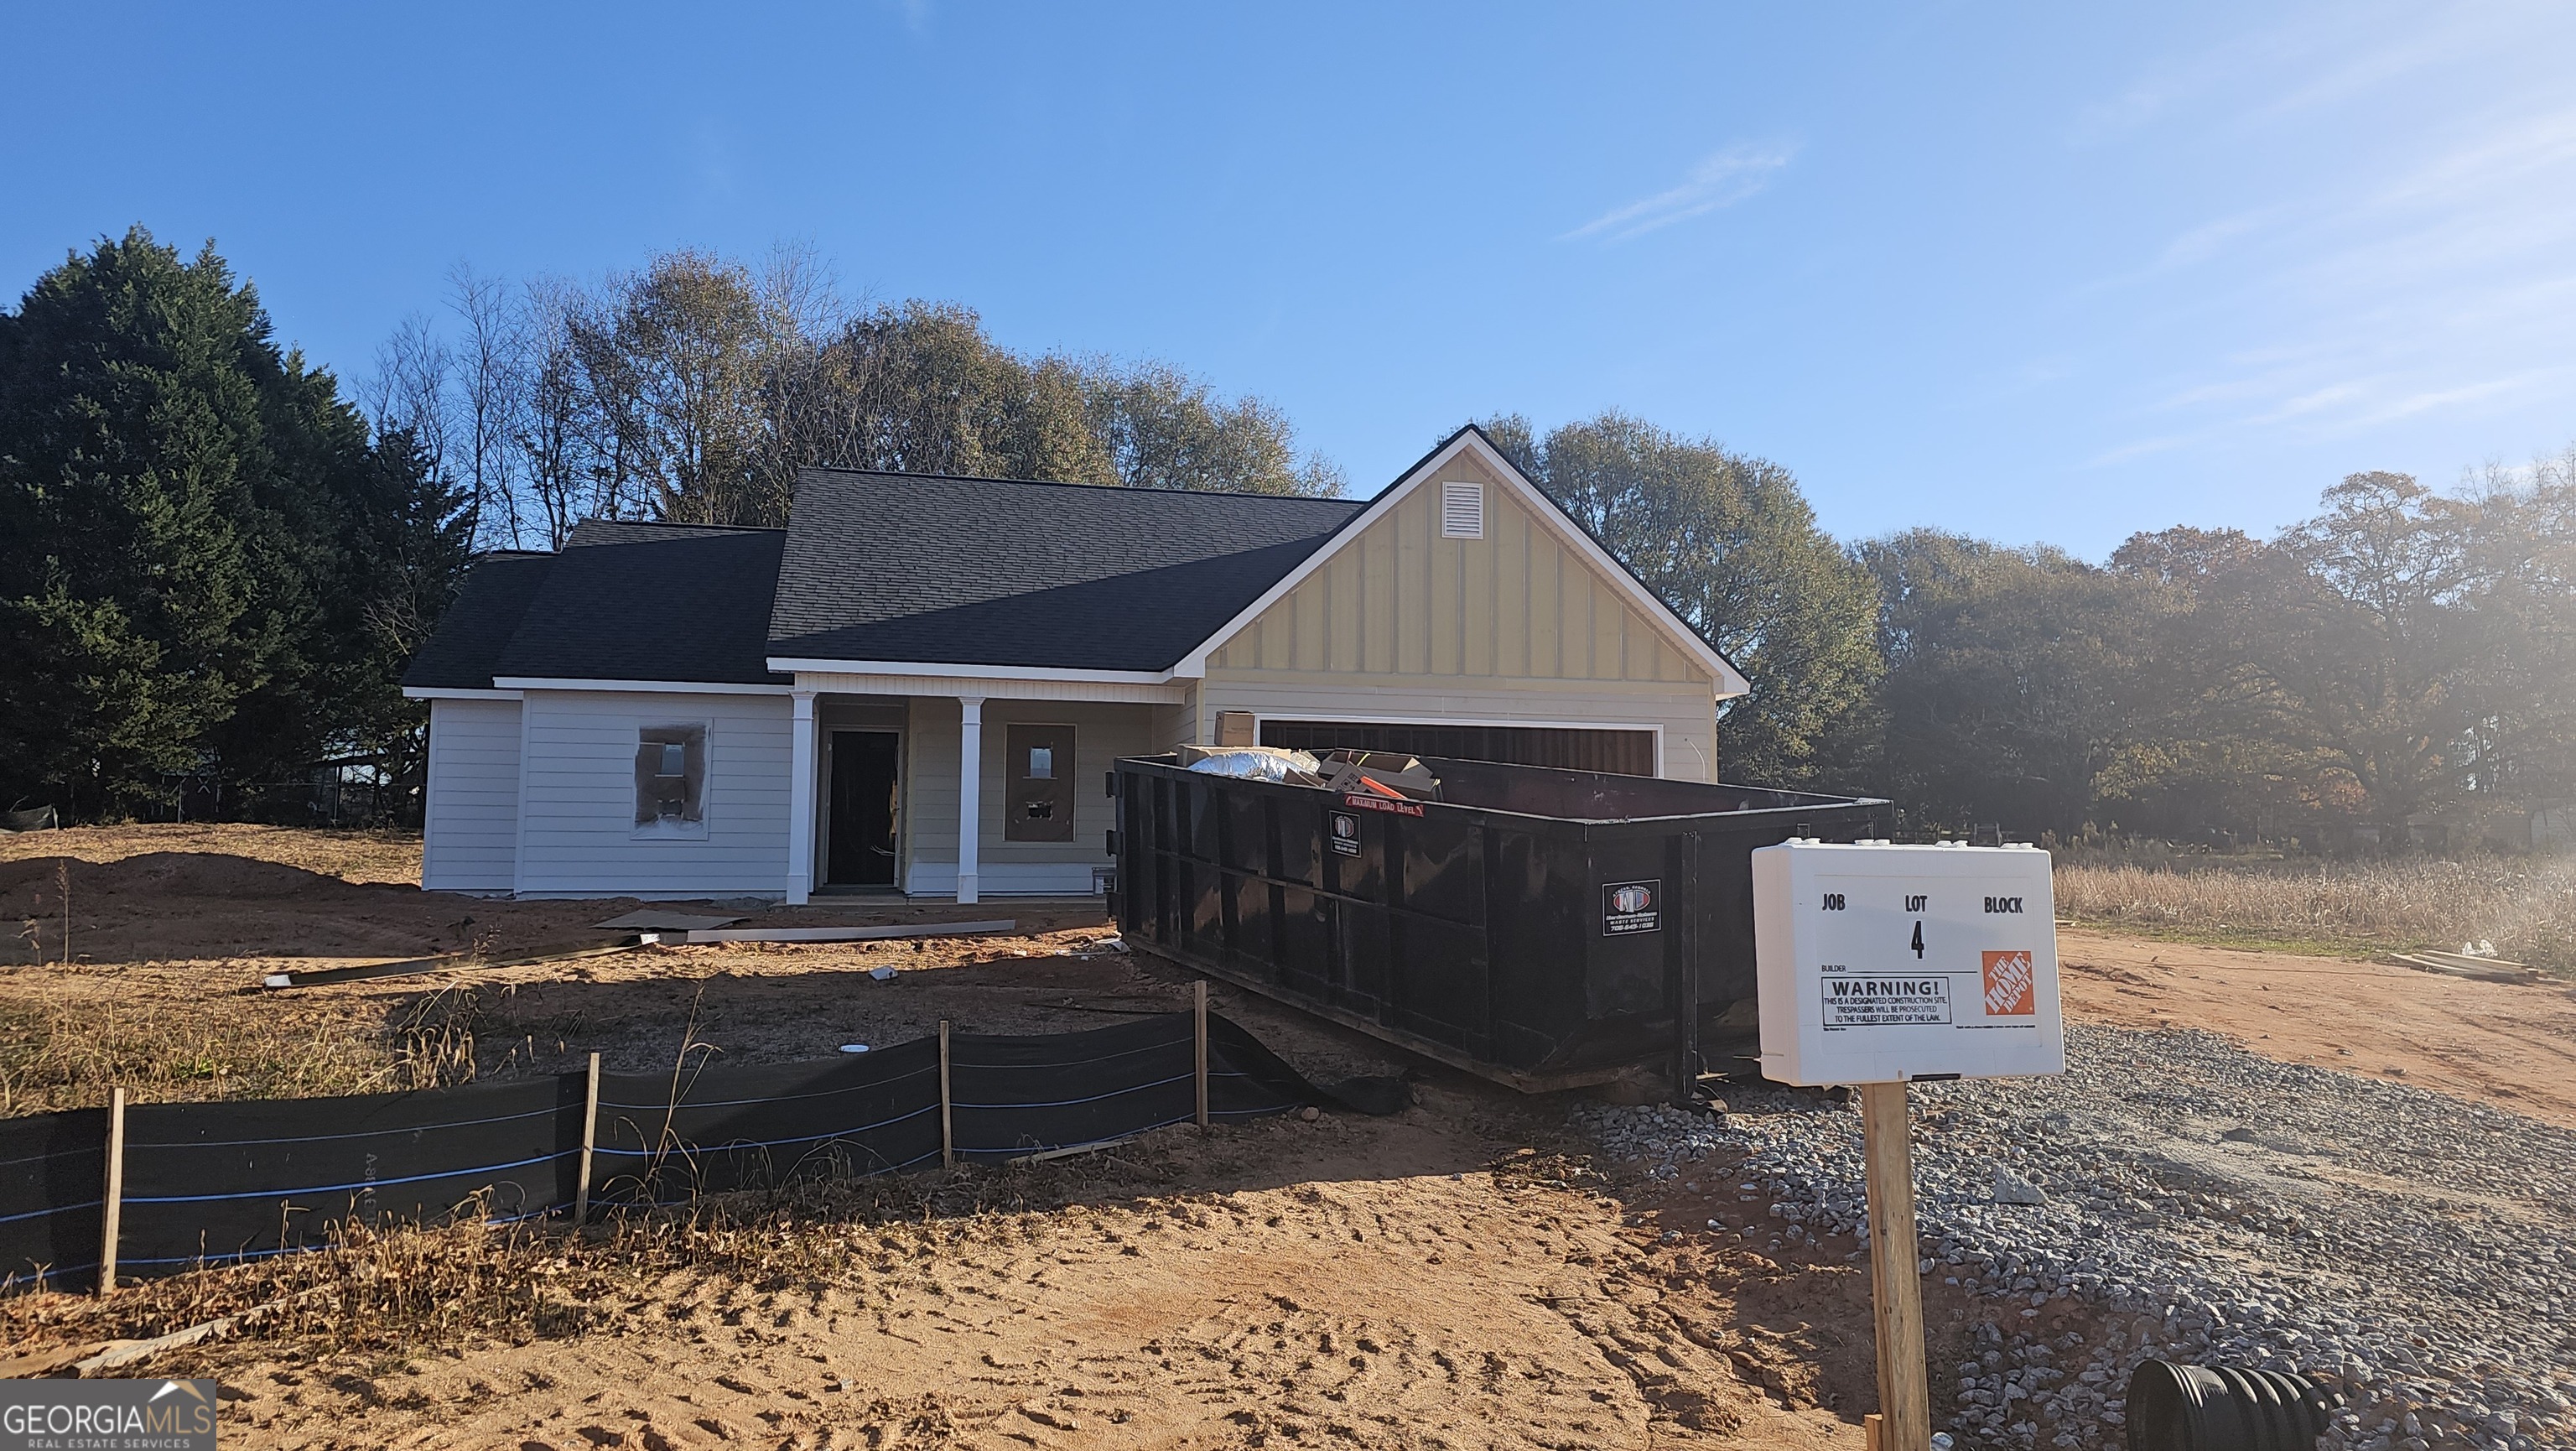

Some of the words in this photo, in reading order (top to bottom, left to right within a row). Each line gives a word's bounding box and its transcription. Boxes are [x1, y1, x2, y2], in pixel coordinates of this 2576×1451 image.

[1379, 802, 1394, 811] LOAD
[1396, 803, 1415, 814] LEVEL
[1821, 893, 1846, 911] JOB
[1905, 895, 1928, 913] LOT
[1984, 897, 2023, 913] BLOCK
[1911, 920, 1924, 960] 4
[1988, 955, 2010, 980] THE
[1832, 981, 1939, 996] WARNING!
[1985, 951, 2032, 1014] HOME
[1850, 996, 1887, 1005] DESIGNATED
[1888, 996, 1933, 1005] CONSTRUCTION
[2002, 972, 2033, 1013] DEPOT
